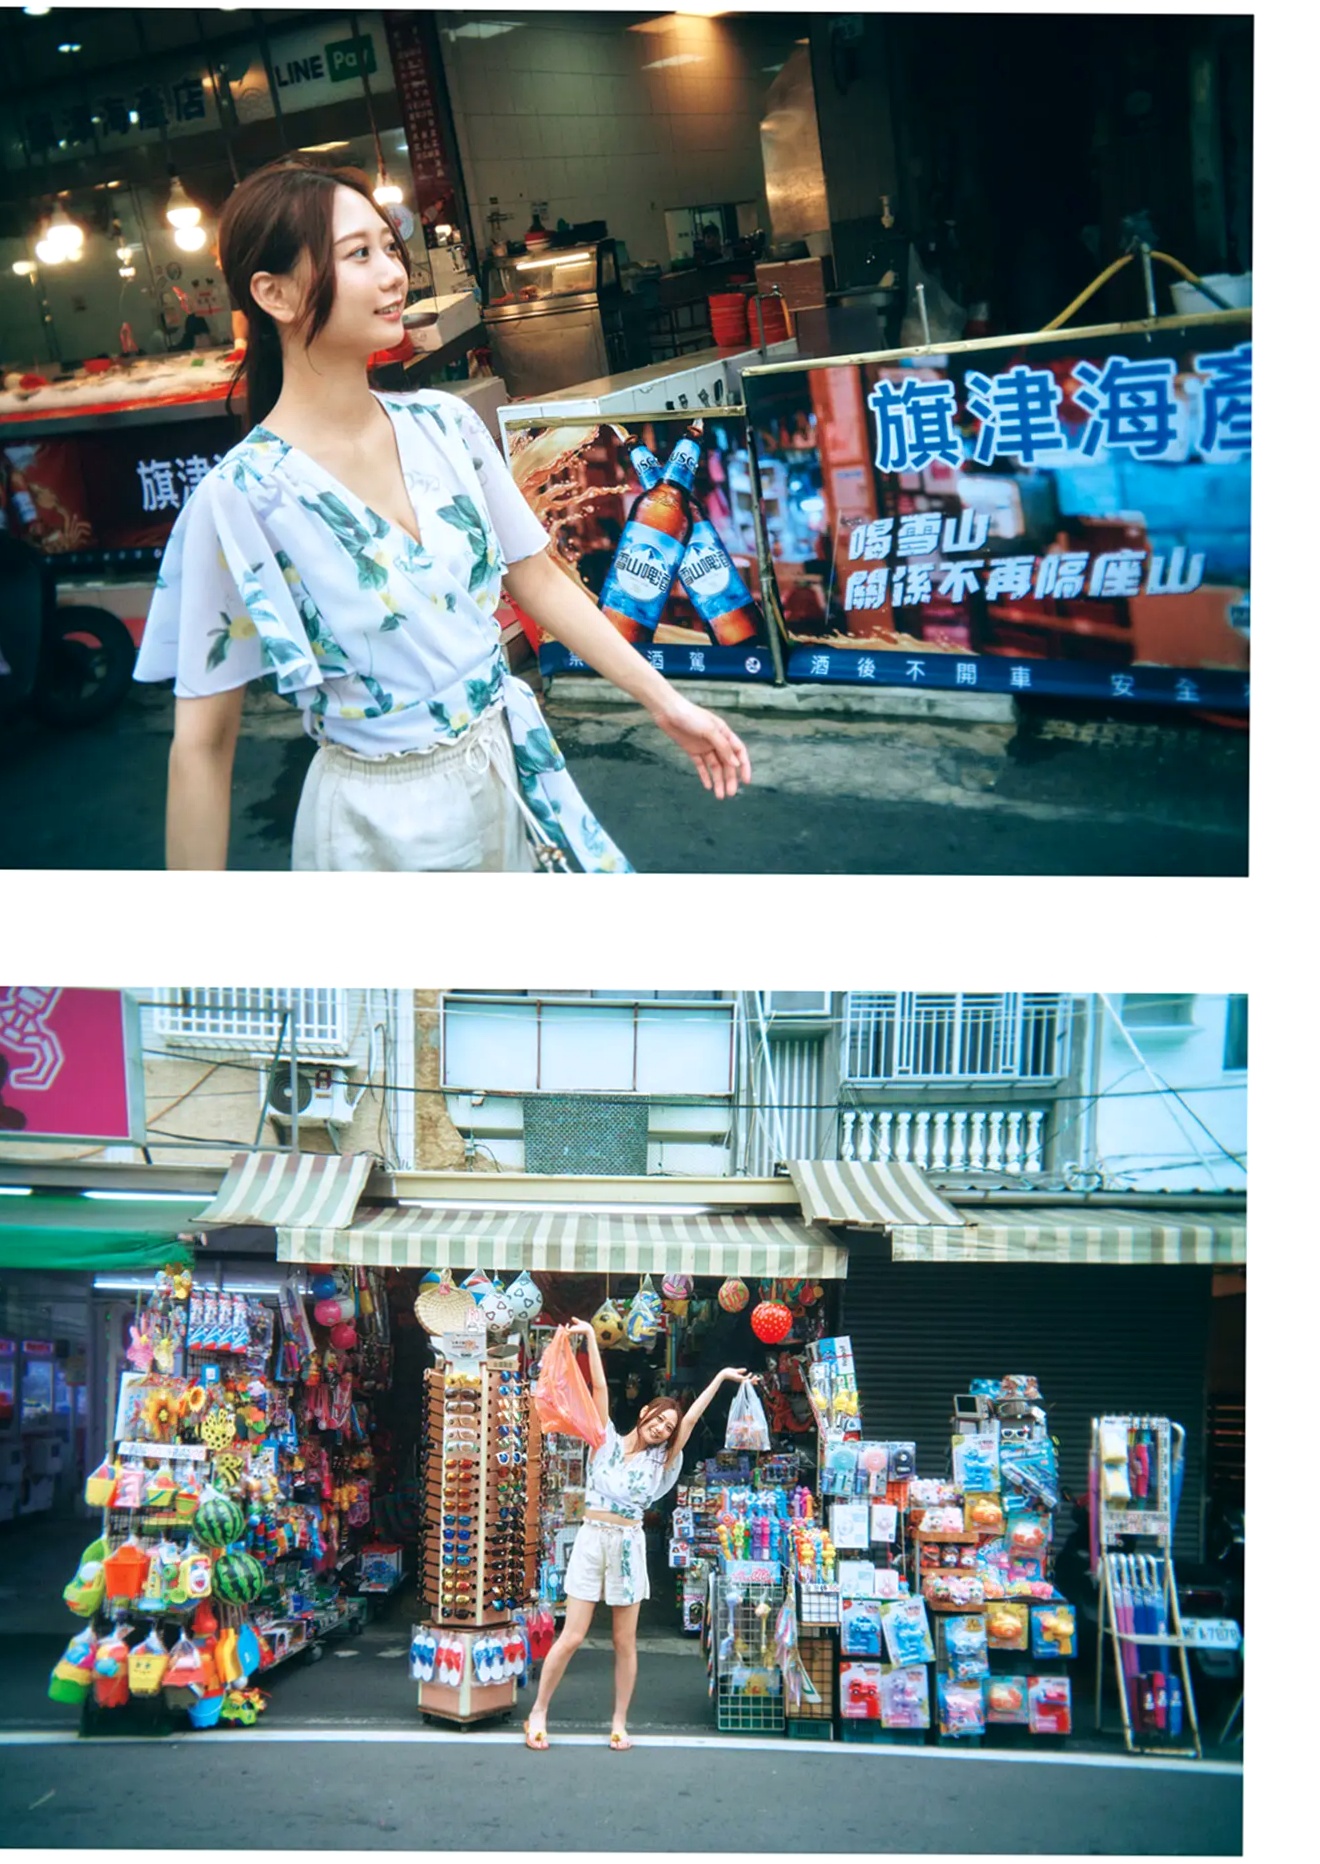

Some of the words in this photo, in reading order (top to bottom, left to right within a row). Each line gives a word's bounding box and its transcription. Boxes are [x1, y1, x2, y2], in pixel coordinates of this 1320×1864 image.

[275, 54, 325, 87] LINE
[848, 508, 991, 560] 喝雪山
[843, 545, 1206, 611] 關係不再隔座山
[810, 654, 1032, 689] 酒後不開車
